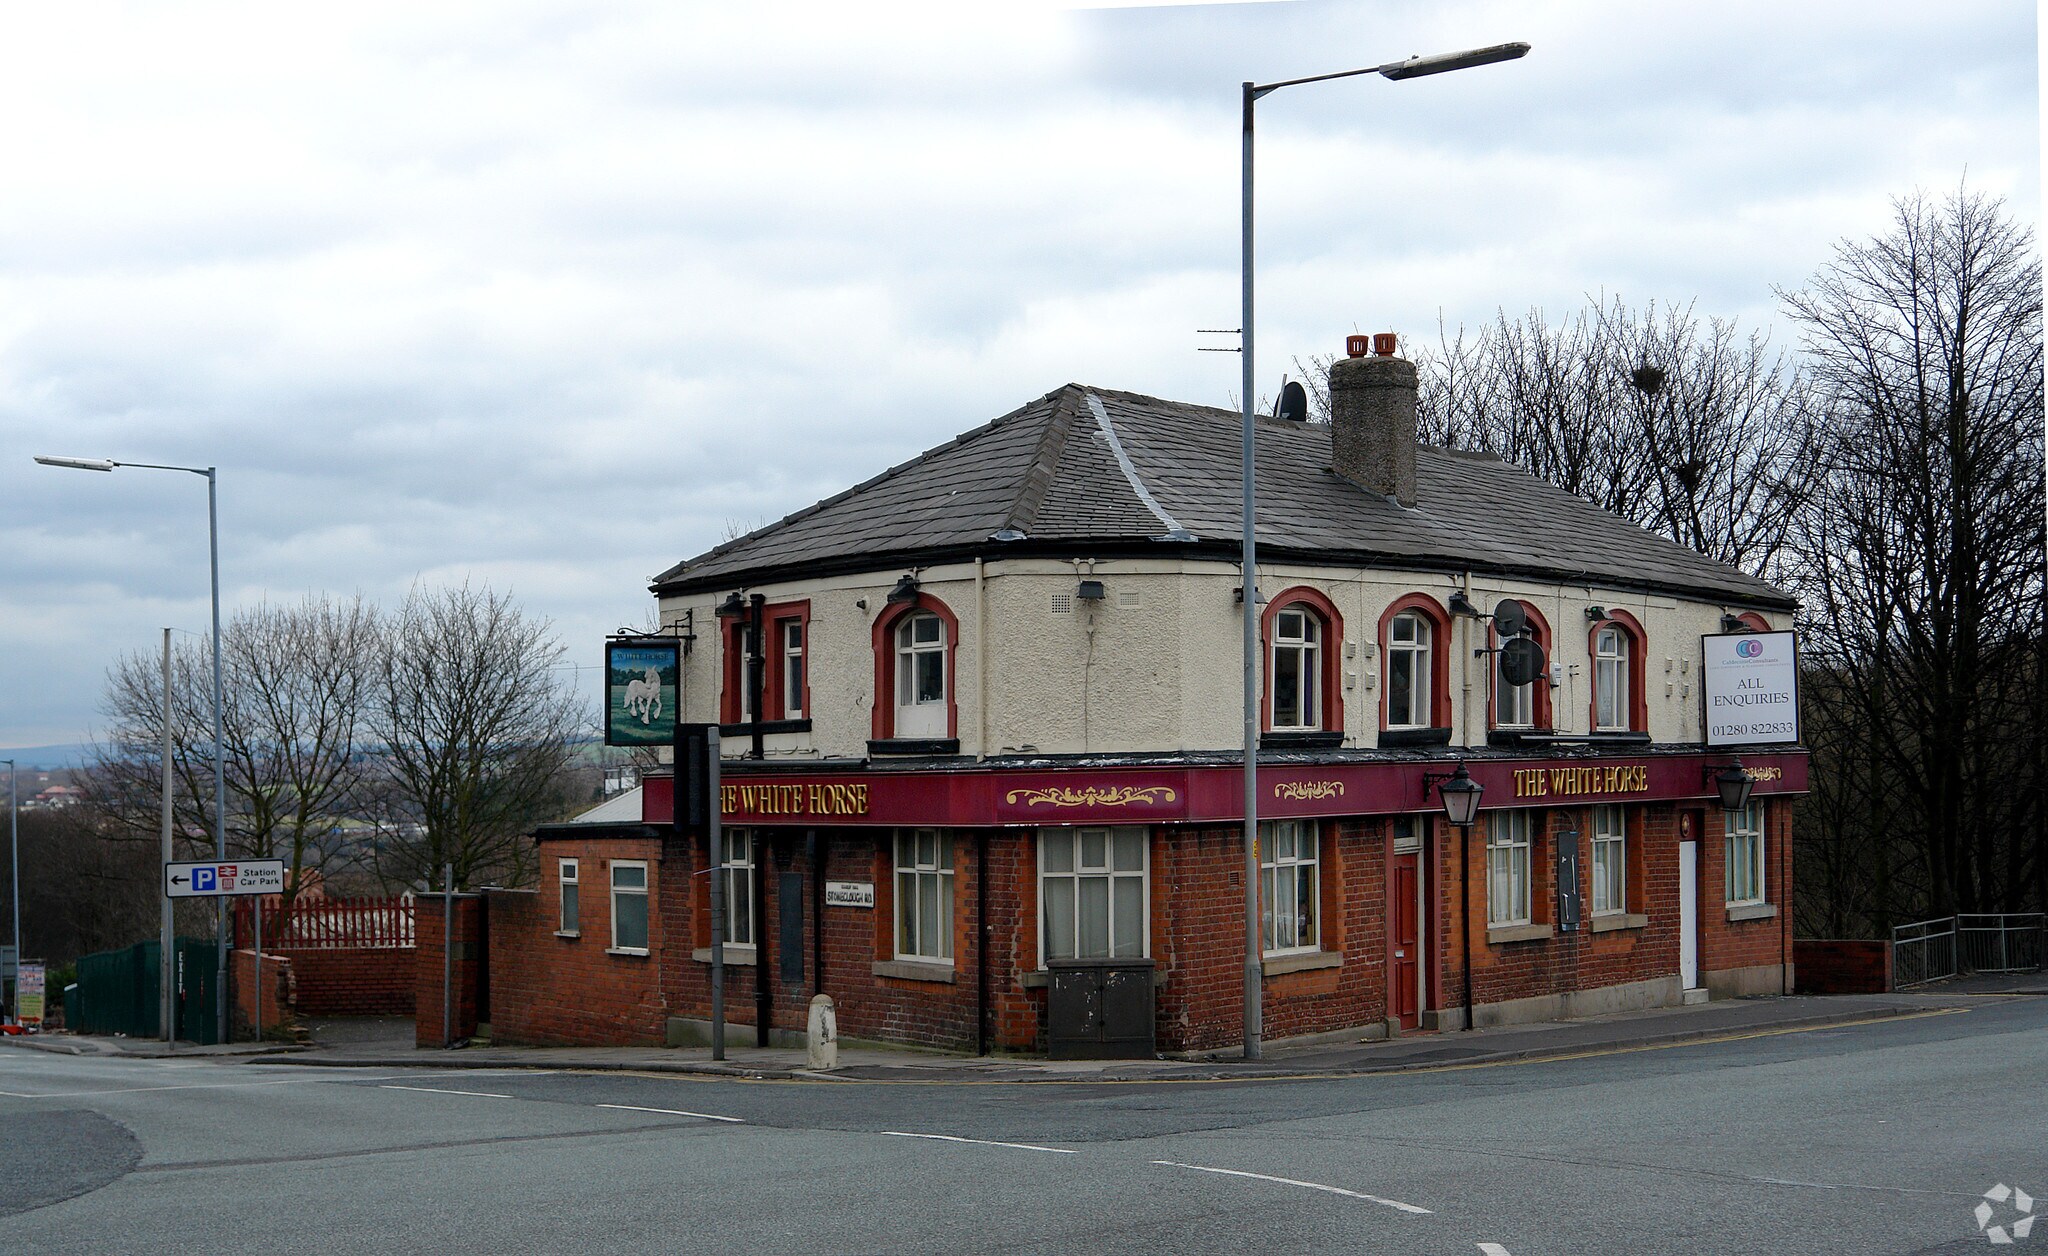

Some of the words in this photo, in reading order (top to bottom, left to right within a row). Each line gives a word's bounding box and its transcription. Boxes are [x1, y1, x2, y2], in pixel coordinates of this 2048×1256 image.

[645, 652, 669, 660] HORSE
[1737, 678, 1765, 690] ALL
[1713, 692, 1789, 707] ENQUIRIES
[1712, 724, 1748, 737] 01280
[1751, 722, 1794, 735] 822833
[1513, 768, 1547, 797] THE
[1548, 766, 1602, 796] WHITE
[1603, 765, 1649, 793] HORSE
[740, 784, 804, 814] WHITE
[807, 783, 870, 815] HORSE
[197, 869, 213, 889] P
[244, 868, 276, 877] Station
[240, 878, 256, 886] Car
[260, 877, 280, 885] Park
